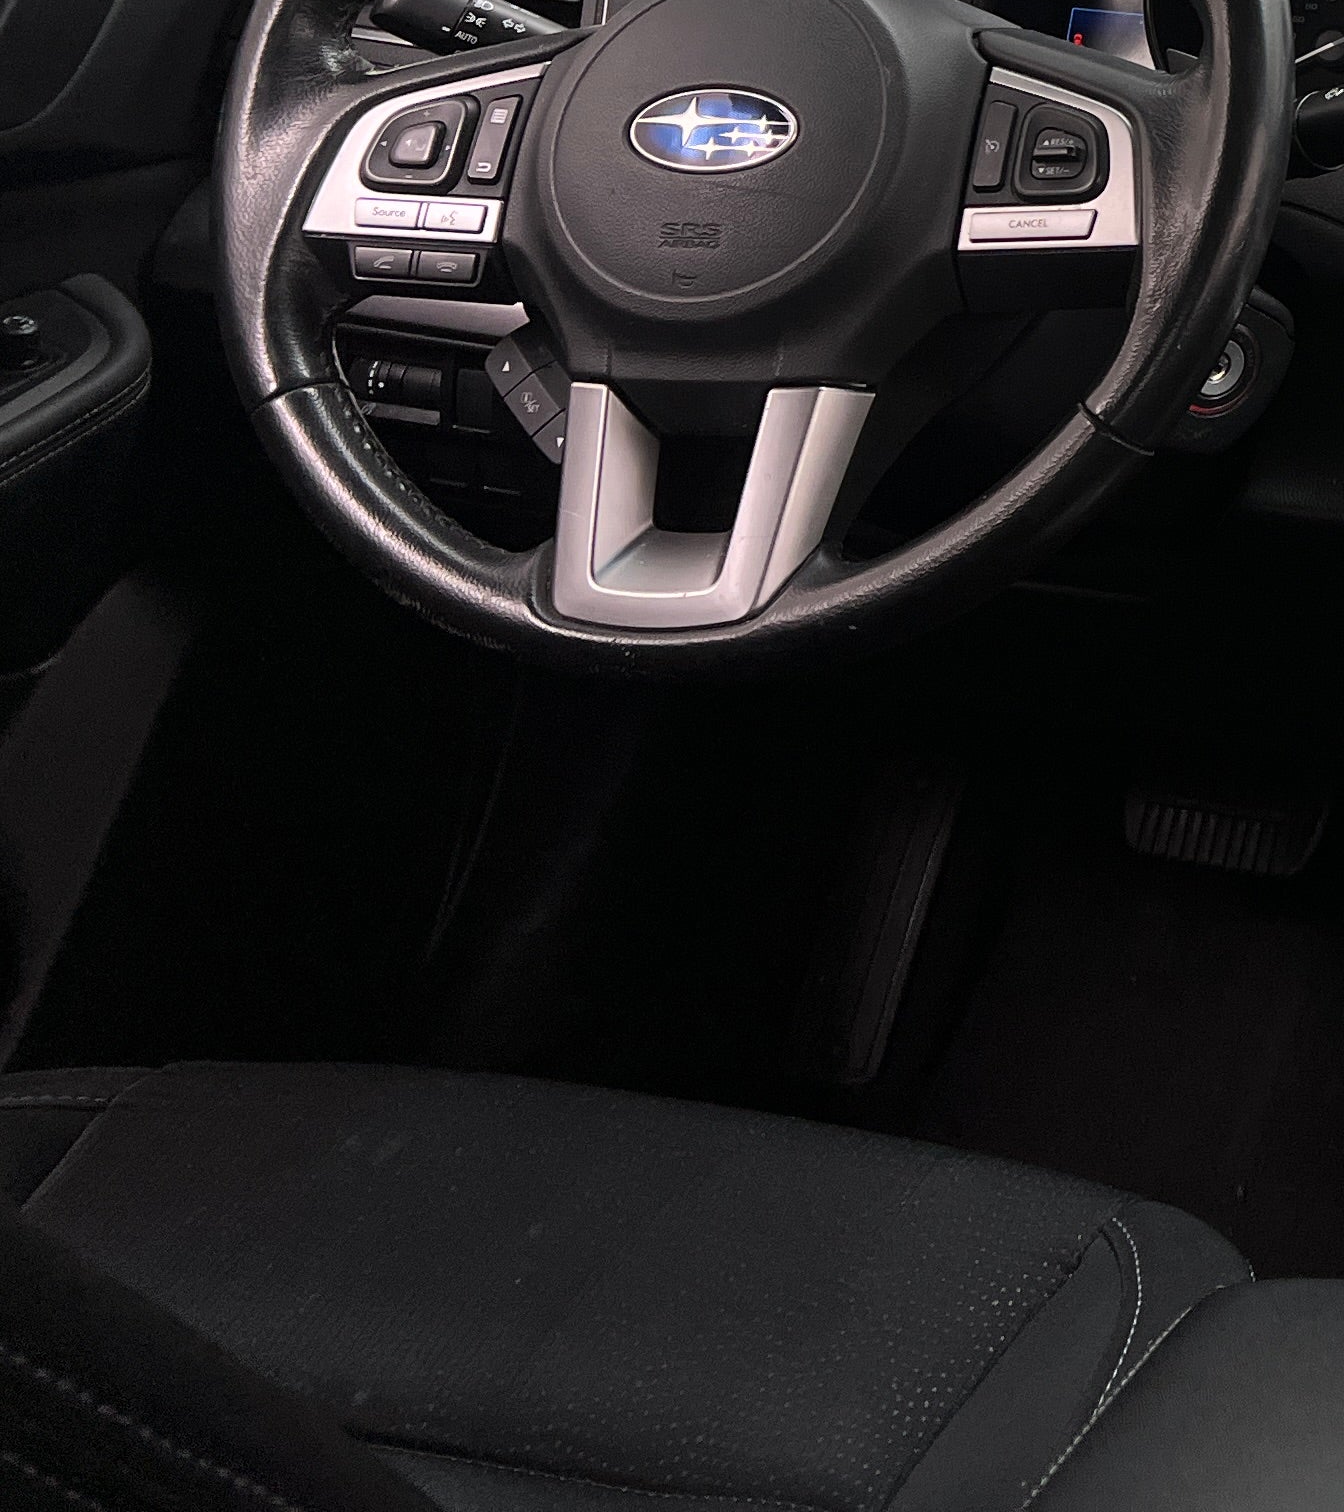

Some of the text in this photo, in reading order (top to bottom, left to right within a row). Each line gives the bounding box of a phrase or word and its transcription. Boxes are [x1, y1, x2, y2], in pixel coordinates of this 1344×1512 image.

[453, 29, 479, 45] AUTO
[371, 206, 407, 218] Source
[1008, 219, 1049, 229] CANCEL
